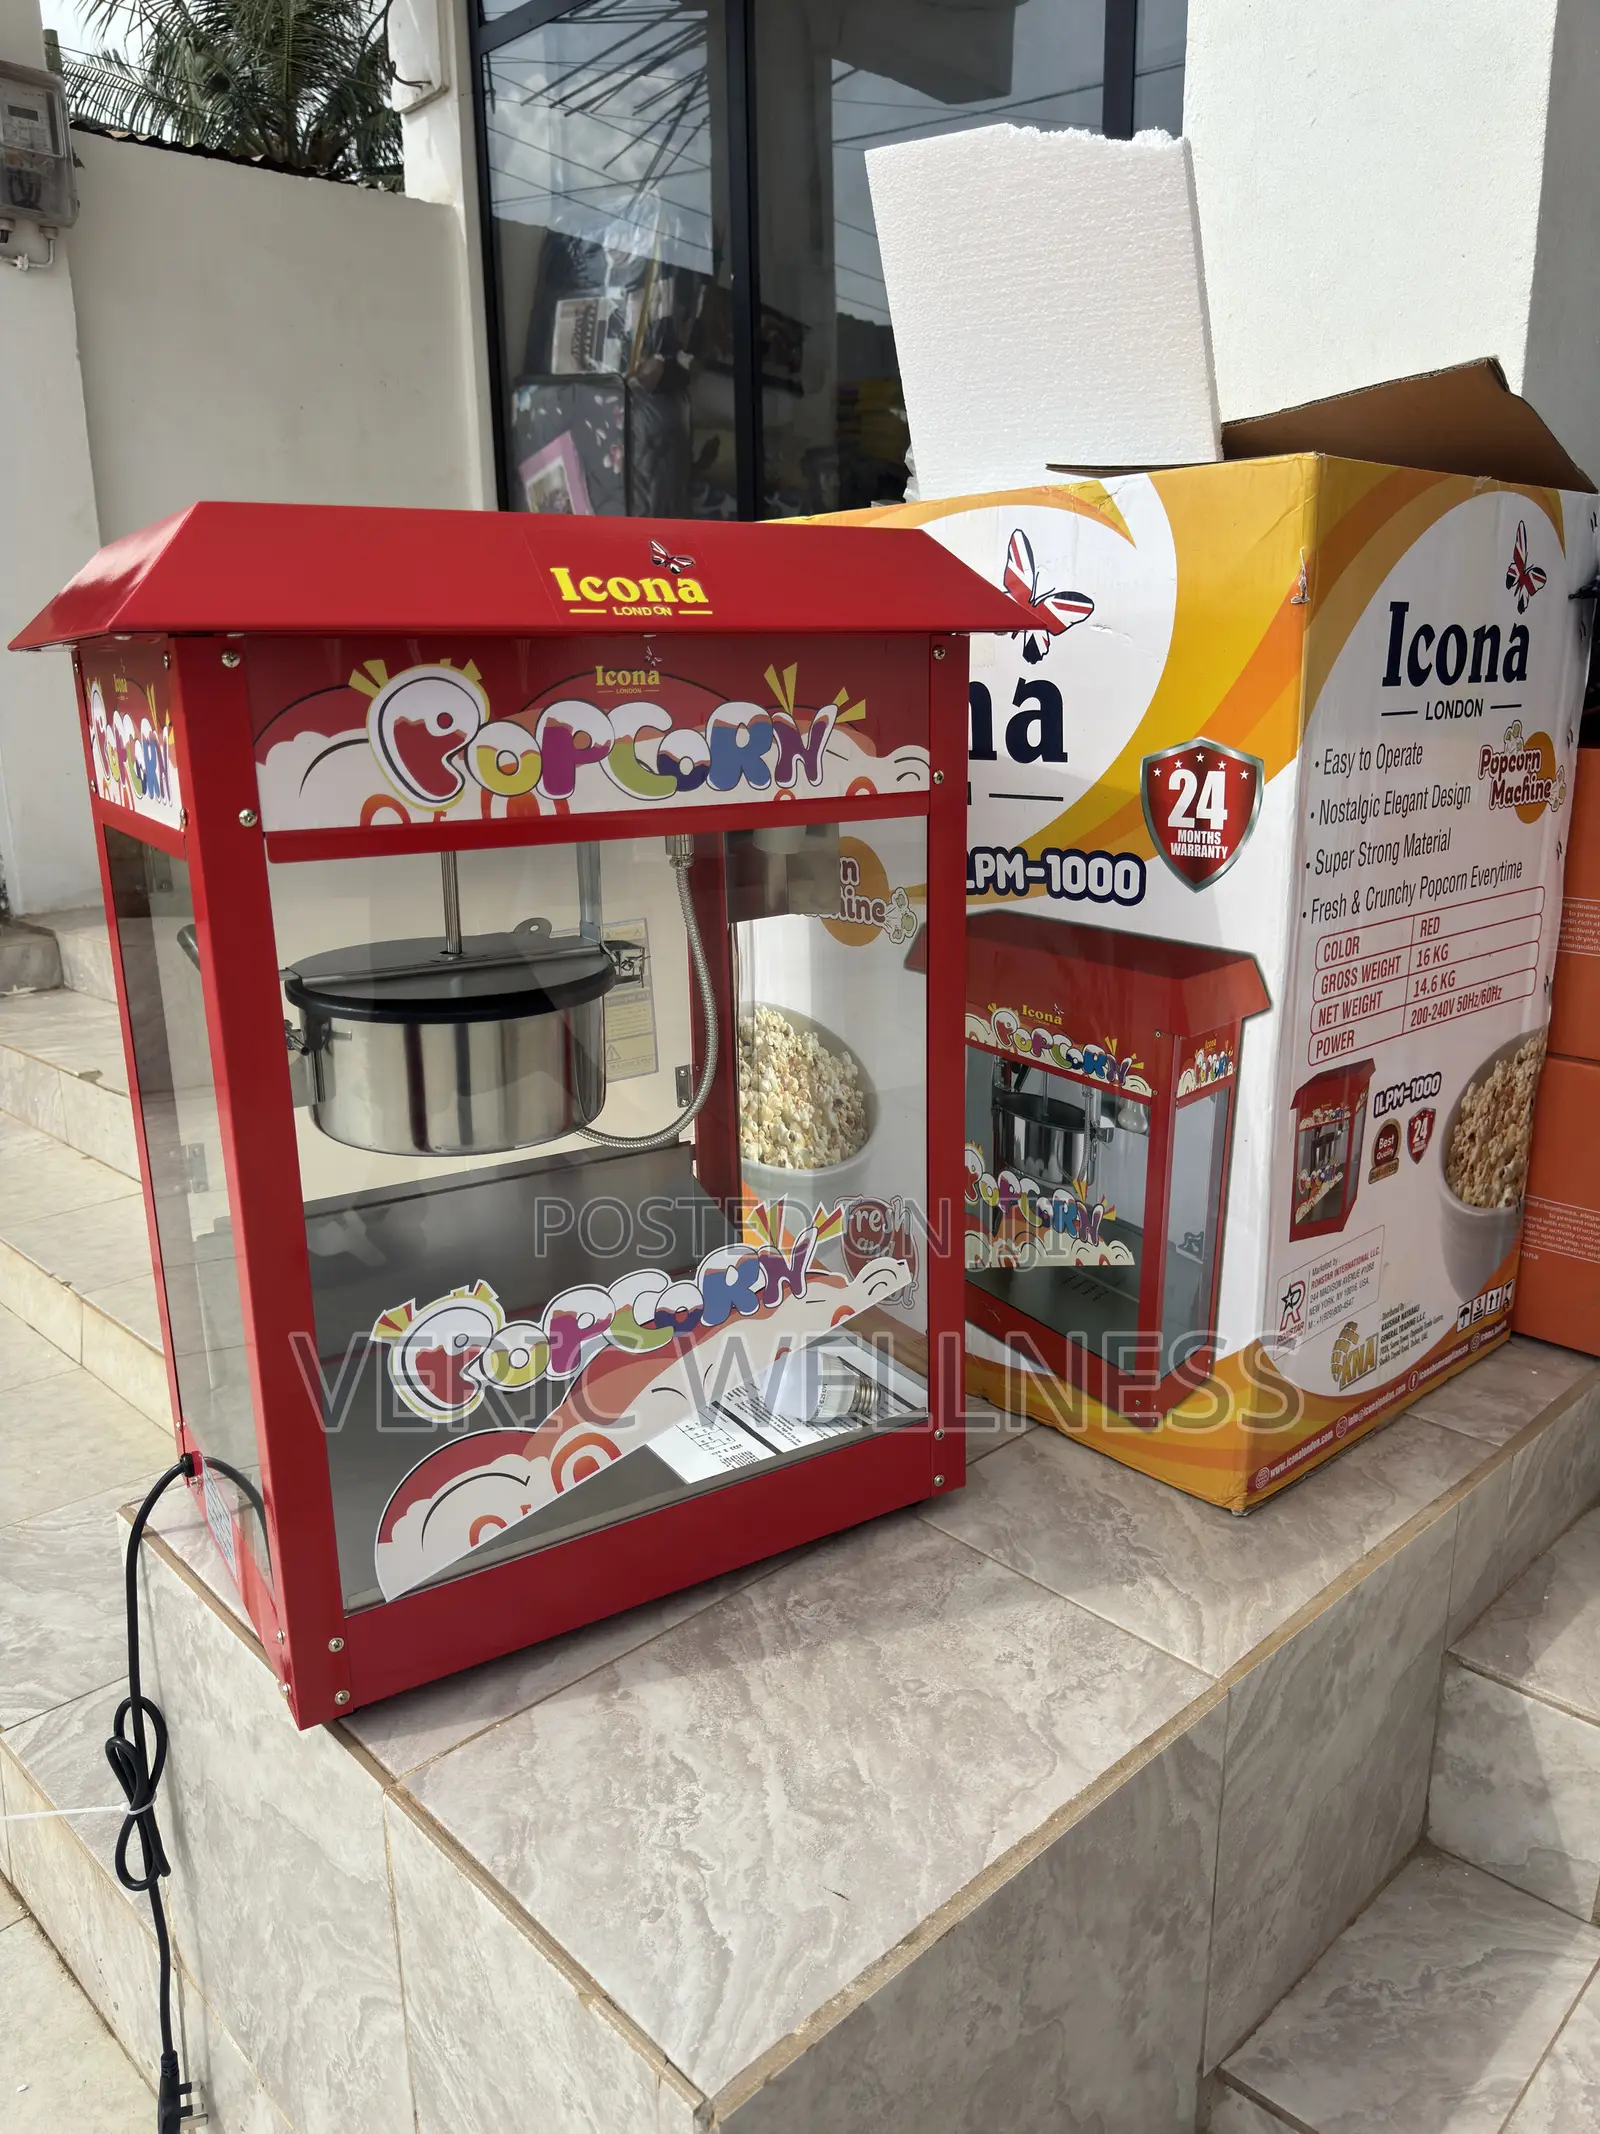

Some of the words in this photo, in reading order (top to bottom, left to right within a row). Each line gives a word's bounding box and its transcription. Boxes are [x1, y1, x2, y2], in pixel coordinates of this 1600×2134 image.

[550, 567, 708, 603] Icona
[613, 606, 672, 617] LONDON
[1382, 601, 1530, 687] Icona
[595, 665, 660, 686] Icona
[1425, 699, 1483, 721] LONDON
[1324, 748, 1355, 778] Easy
[1359, 746, 1371, 771] to
[1376, 742, 1423, 776] Operate
[1480, 749, 1541, 779] Popcorn
[1168, 768, 1228, 830] 24
[1319, 793, 1380, 826] Nostalgic
[1383, 786, 1429, 818] Elegant
[1432, 783, 1471, 810] Design
[1491, 772, 1552, 807] Machine
[1170, 842, 1228, 859] WARRANTY
[1178, 829, 1221, 845] MONTHS
[1315, 848, 1354, 877] Super
[1358, 842, 1400, 867] Strong
[1403, 827, 1451, 858] Material
[1311, 894, 1347, 924] Fresh
[1351, 893, 1361, 914] &
[1366, 880, 1416, 912] Crunchy
[1419, 871, 1468, 901] Popcorn
[1470, 860, 1523, 890] Everytime
[1324, 936, 1360, 963] COLOR
[1420, 916, 1440, 938] RED
[1321, 968, 1358, 996] GROSS
[1361, 955, 1401, 985] WEIGHT
[1416, 948, 1431, 968] 16
[1432, 943, 1449, 963] KG
[1022, 1004, 1062, 1026] Icona
[1318, 1004, 1339, 1027] NET
[1342, 990, 1383, 1021] WEIGHT
[1413, 975, 1438, 998] 14.6
[1439, 969, 1456, 990] KG
[1316, 1029, 1355, 1059] POWER
[1410, 997, 1454, 1027] 200-240V
[1456, 984, 1502, 1017] 50Hz/60Hz
[1374, 1073, 1441, 1117] ILPM-1000
[1379, 1134, 1394, 1149] Best
[1413, 1117, 1428, 1143] 24
[1376, 1148, 1394, 1160] Quality
[1341, 1338, 1375, 1387] KNA
